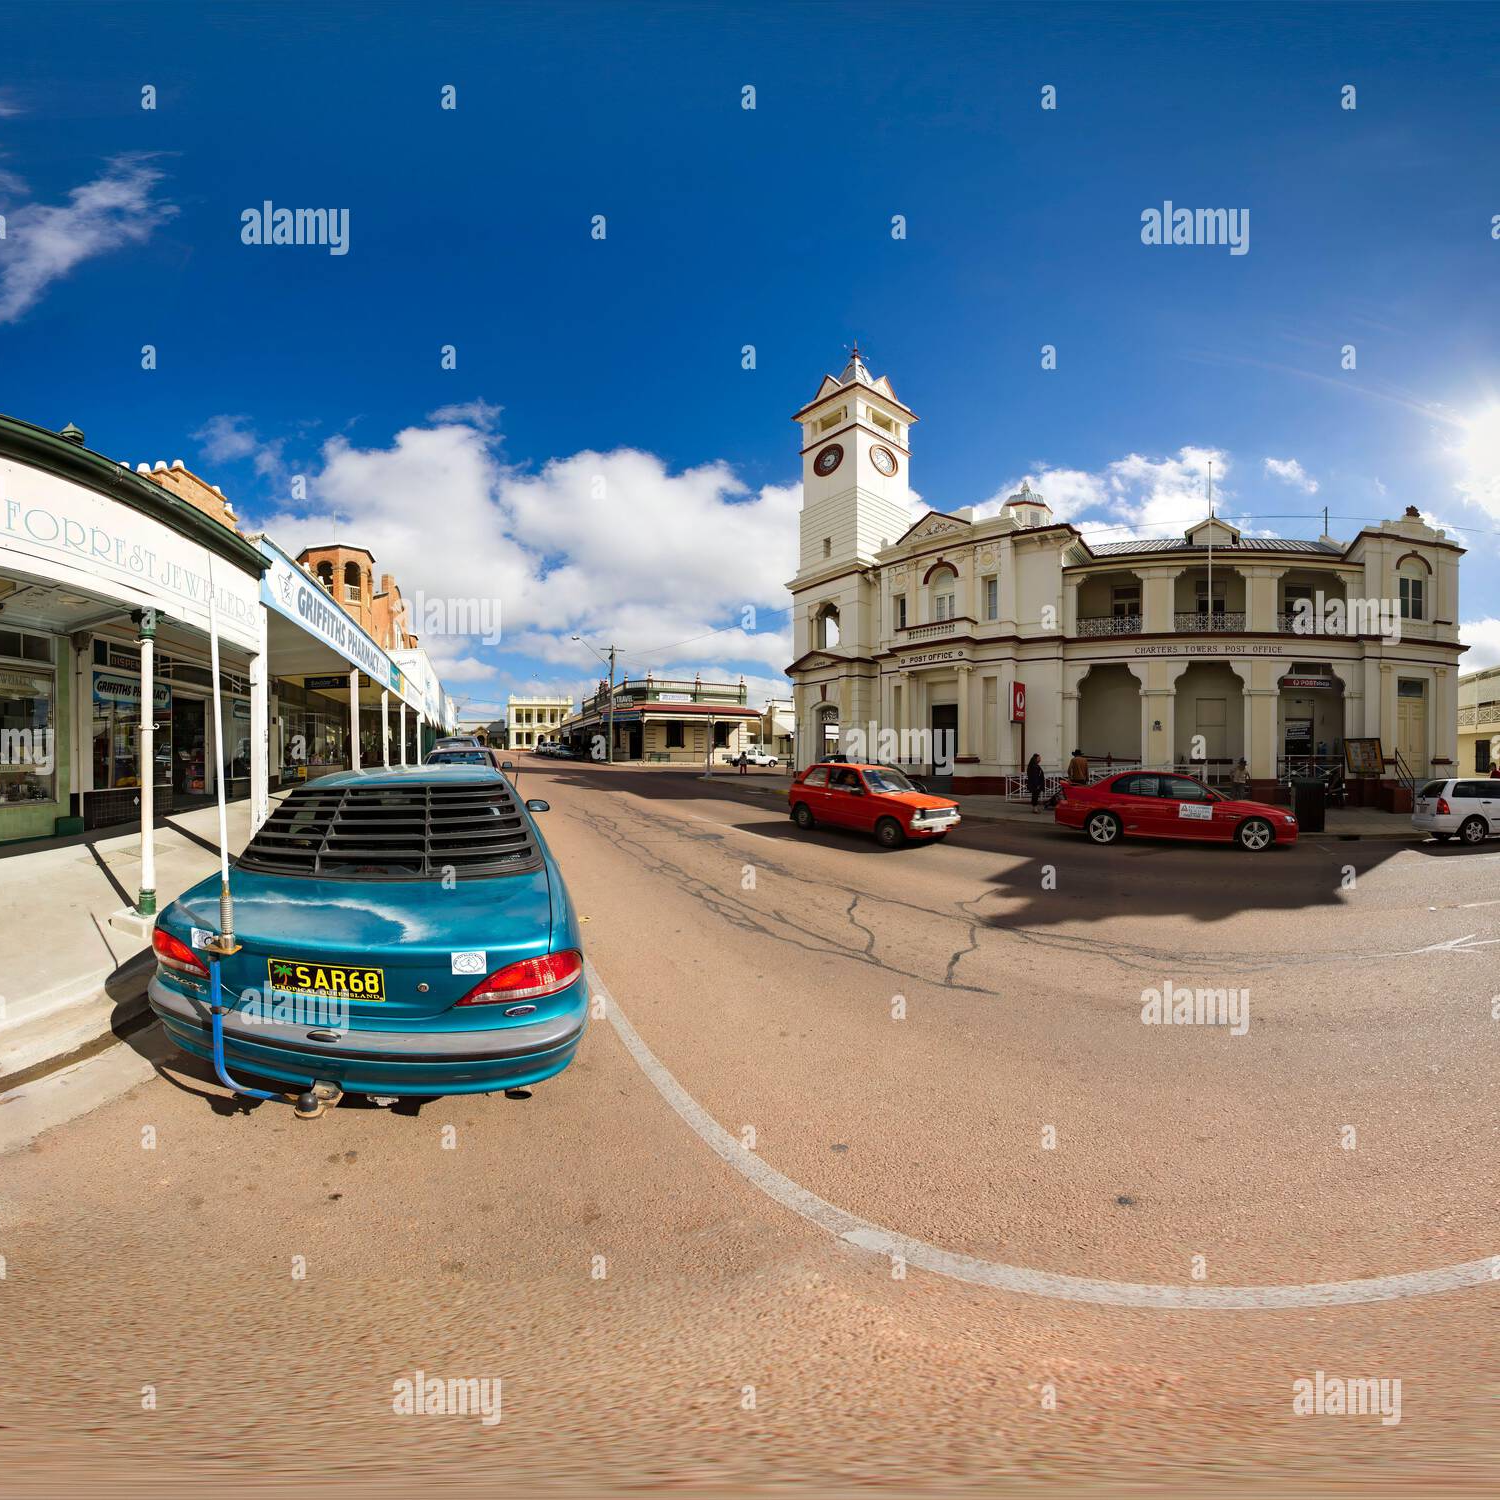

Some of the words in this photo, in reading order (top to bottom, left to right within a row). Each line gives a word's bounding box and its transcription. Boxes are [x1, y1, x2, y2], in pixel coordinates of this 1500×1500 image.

[4, 498, 157, 579] FORREST
[160, 560, 256, 626] JEWELLERS
[297, 586, 347, 648] GRIFFITHS
[347, 628, 381, 676] PHARMACY
[909, 653, 927, 664] POST
[927, 651, 953, 661] OFFICE
[1134, 646, 1178, 654] CHARTERS
[1184, 645, 1218, 653] TOWERS
[1225, 645, 1246, 653] POST
[1252, 645, 1283, 653] OFFICE
[96, 680, 132, 696] GRIFFITHS
[132, 685, 168, 701] PHACY
[295, 966, 380, 994] SAR68
[274, 984, 318, 994] TROPICAL
[319, 989, 380, 999] QUEENSLAND
